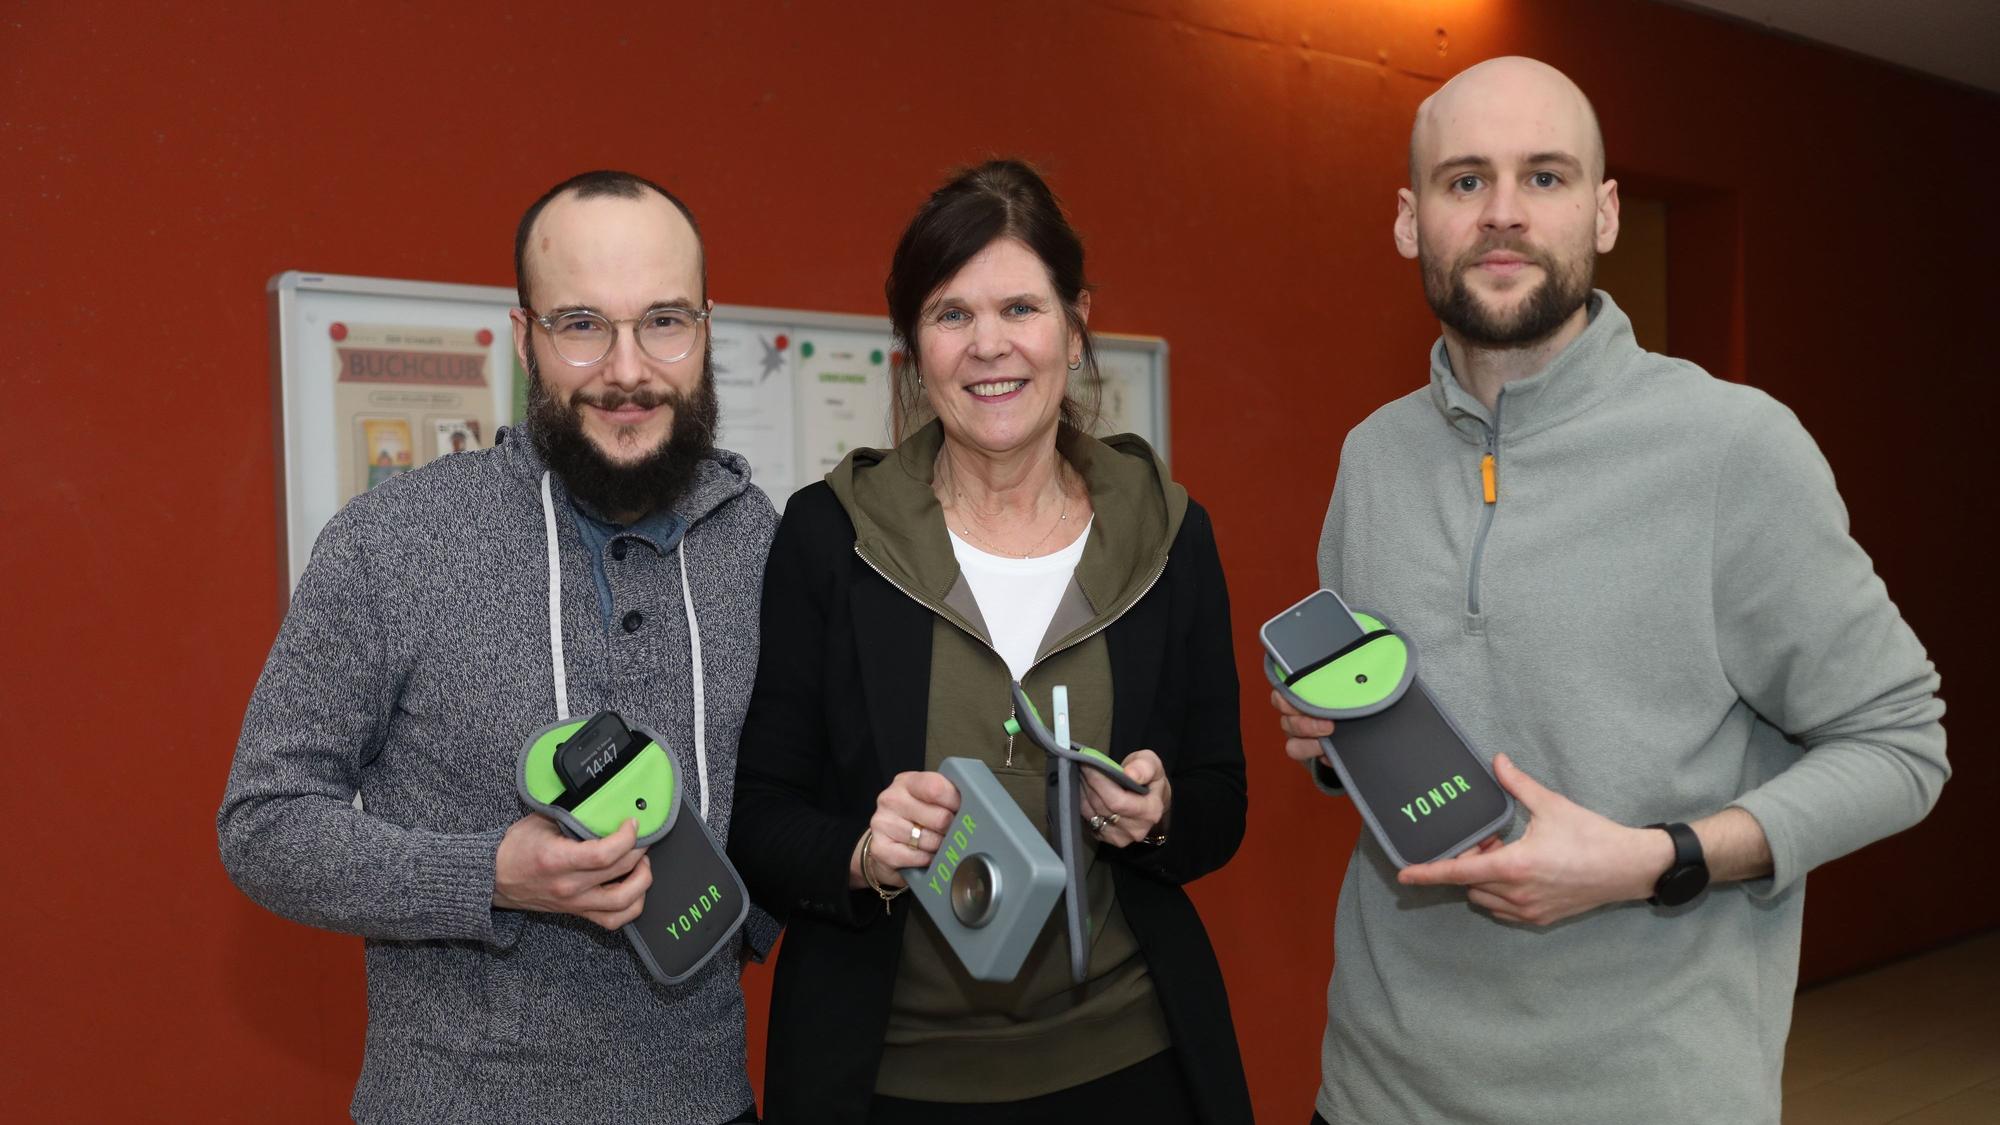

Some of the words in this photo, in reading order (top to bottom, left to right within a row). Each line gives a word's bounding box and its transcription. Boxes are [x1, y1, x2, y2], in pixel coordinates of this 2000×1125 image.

[350, 352, 481, 380] BUCHCLUB
[586, 743, 618, 779] 14:47
[1400, 775, 1472, 823] YONDR
[928, 814, 977, 896] YONDR
[666, 884, 722, 940] YONDR
